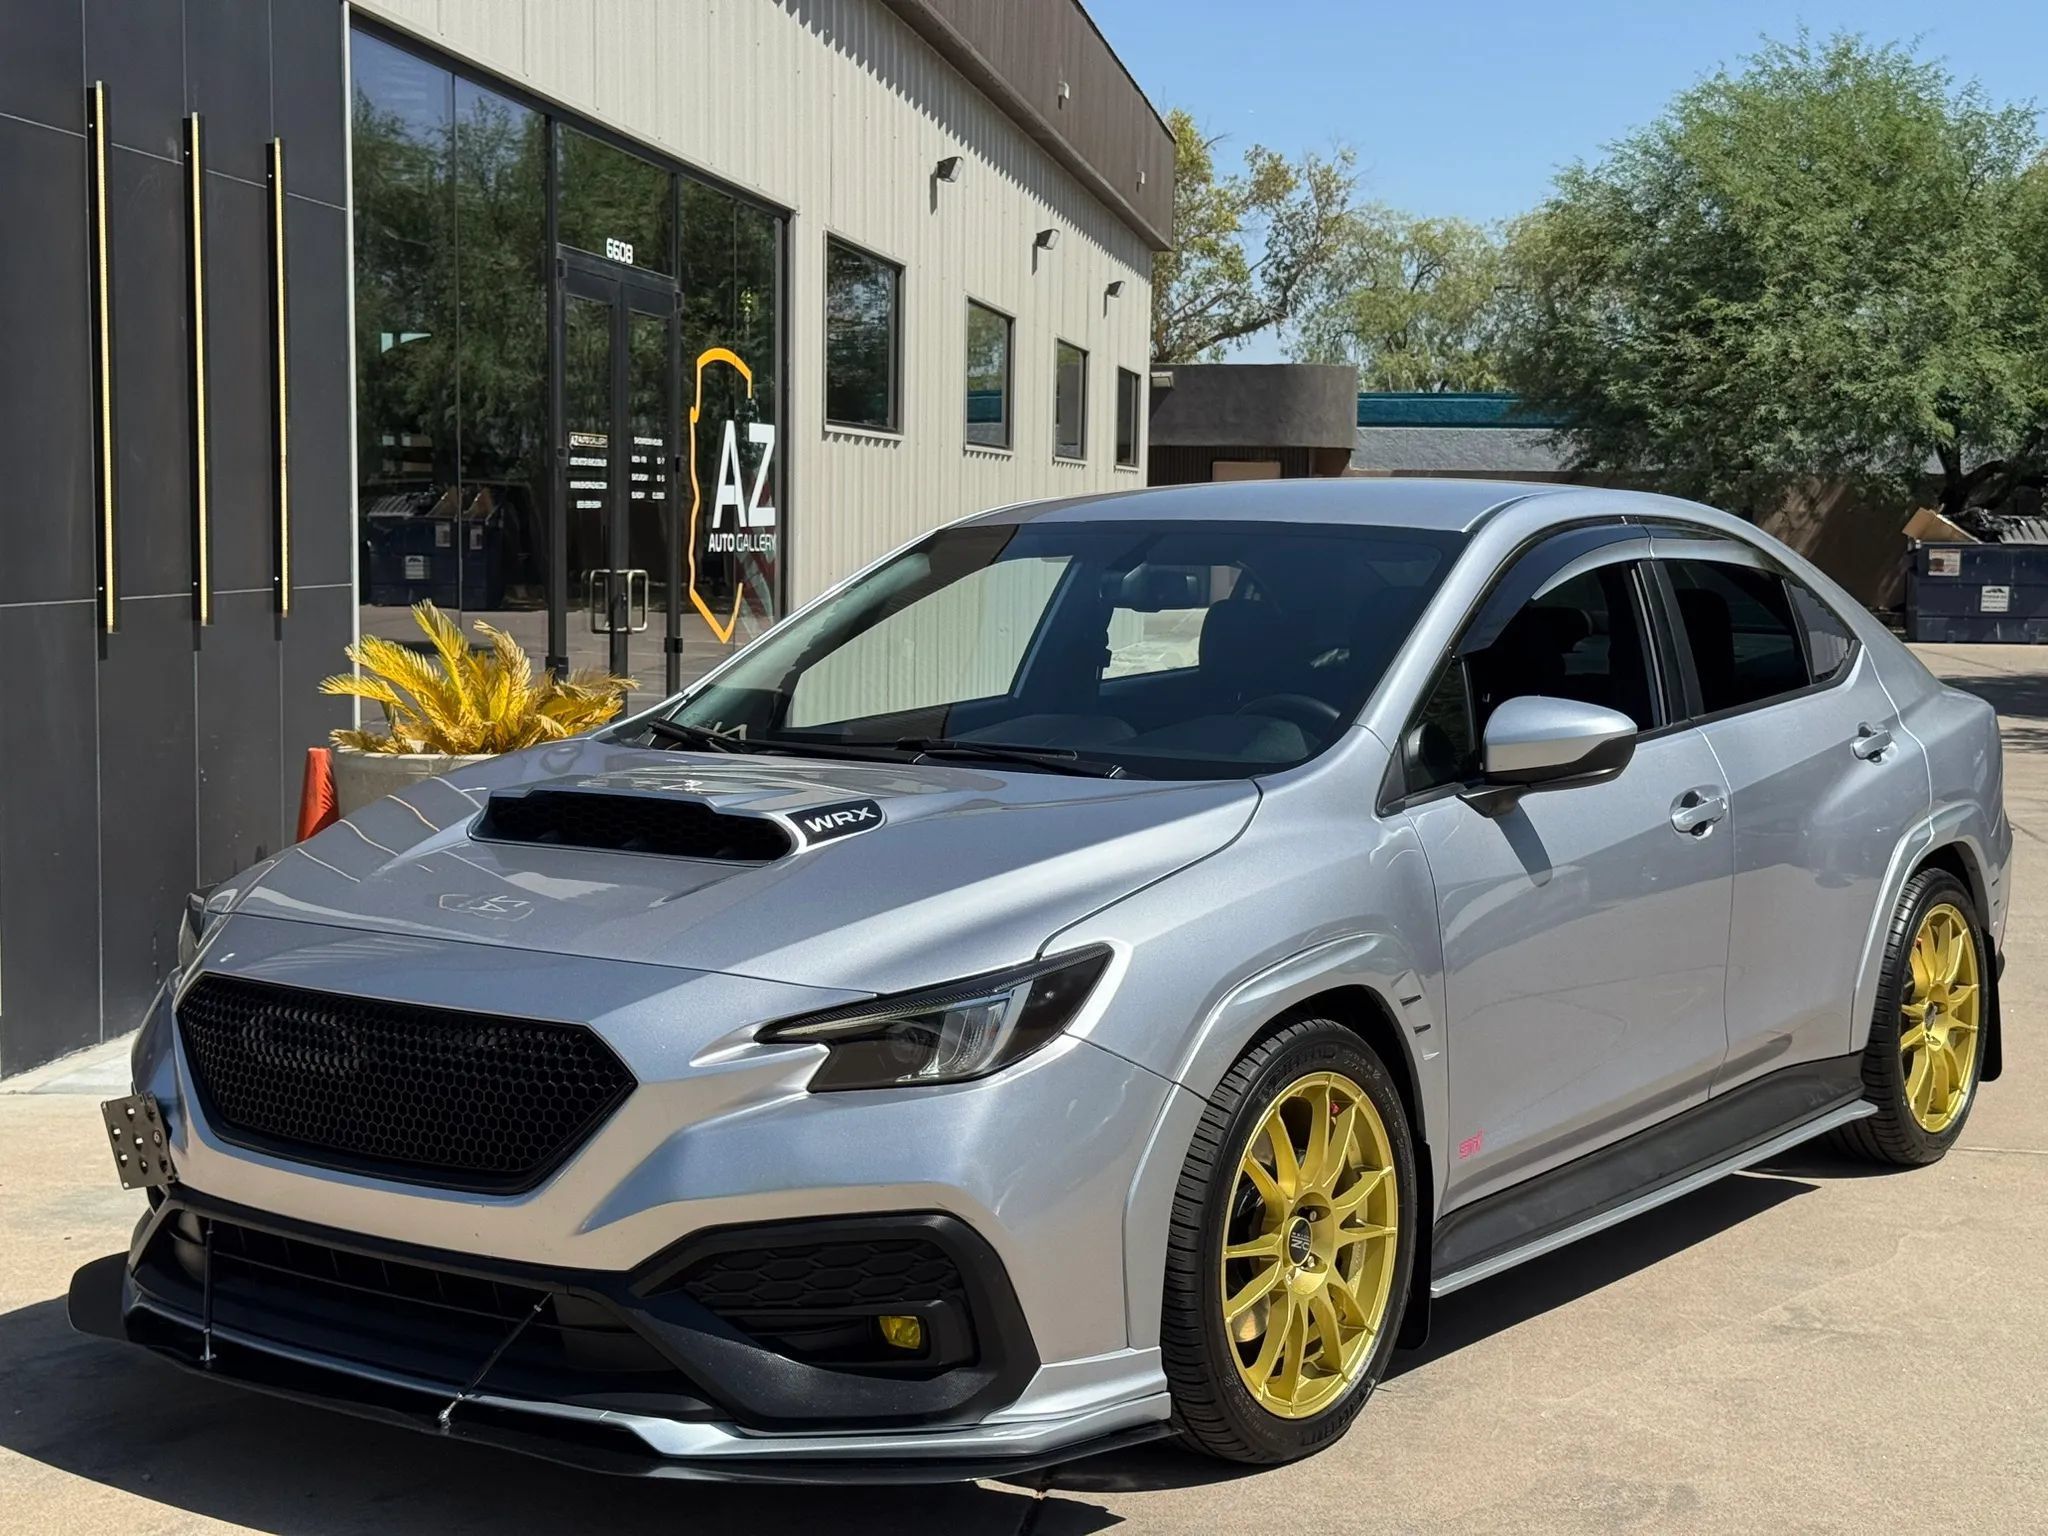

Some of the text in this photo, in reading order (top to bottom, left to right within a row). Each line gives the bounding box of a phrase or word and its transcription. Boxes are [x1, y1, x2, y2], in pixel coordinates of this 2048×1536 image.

[606, 237, 634, 265] 6608
[712, 419, 776, 529] AZ
[708, 532, 777, 553] AUTO GALLERY
[804, 806, 878, 833] WRX
